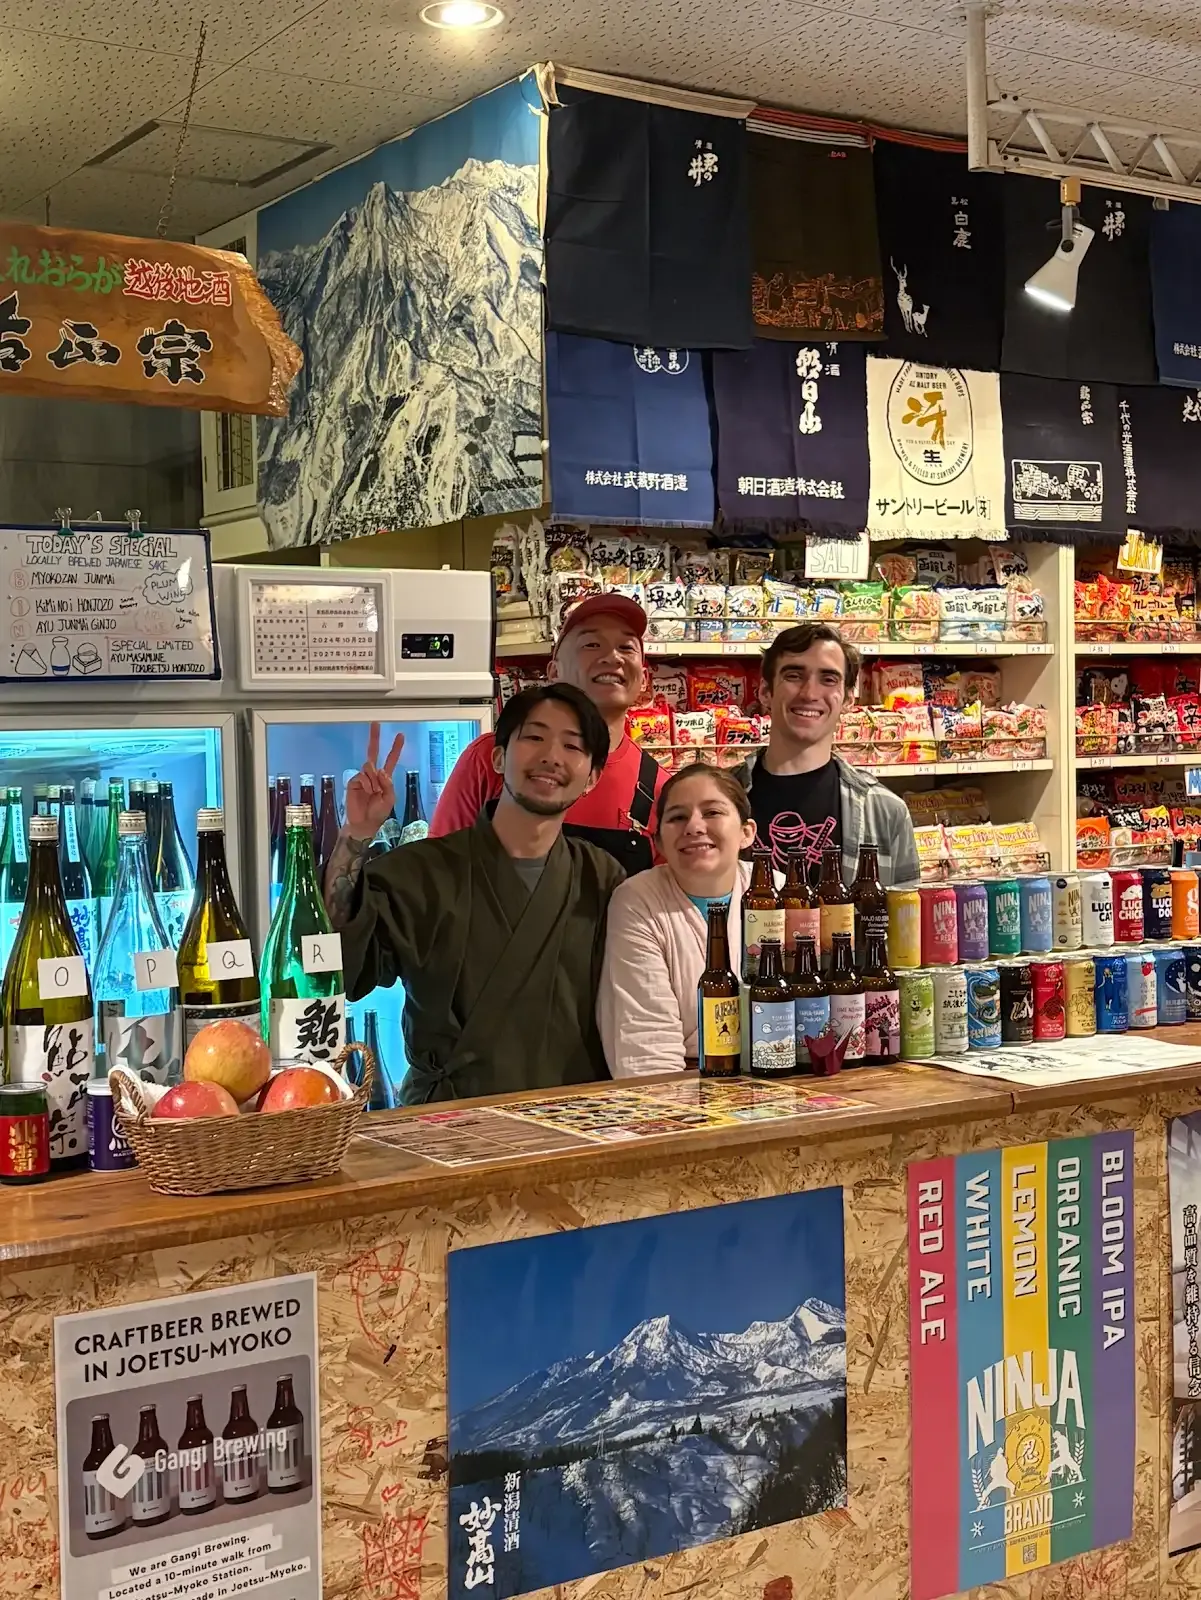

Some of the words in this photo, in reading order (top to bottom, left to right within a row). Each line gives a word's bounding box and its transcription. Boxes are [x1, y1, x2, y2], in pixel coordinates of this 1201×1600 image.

[0, 247, 122, 294] れおらが
[122, 258, 232, 307] 越後地酒
[923, 449, 942, 464] 生
[584, 470, 688, 492] 株式会社武蔵野酒造
[737, 476, 845, 500] 朝日酒造株式会社
[26, 535, 103, 555] TODAY'S
[26, 556, 61, 565] LOCALLY
[68, 557, 102, 567] BREWED
[106, 558, 143, 569] JAPANESE
[148, 560, 168, 570] SAKE
[31, 572, 78, 585] MYOKOZAN
[158, 589, 186, 601] WINE
[36, 619, 54, 634] AYU
[933, 901, 957, 923] NINJ
[963, 899, 988, 924] NINJ
[996, 892, 1020, 914] NINJ
[1028, 892, 1051, 913] NINJ
[1091, 902, 1112, 913] LUC
[222, 950, 245, 970] Q
[312, 944, 325, 964] R
[146, 958, 157, 984] P
[918, 1179, 944, 1254] RED
[1101, 1150, 1125, 1276] BLOOM
[965, 1169, 991, 1302] WHITE
[1012, 1163, 1037, 1299] LEMON
[1057, 1157, 1081, 1318] ORGANIC
[919, 1270, 946, 1345] ALE
[1102, 1287, 1126, 1350] IPA
[74, 1315, 204, 1356] CRAFTBEER
[211, 1298, 301, 1331] BREWED
[84, 1361, 108, 1383] IN
[116, 1327, 292, 1378] JOETSU-MYOKO
[966, 1348, 1086, 1460] NINJA
[154, 1440, 207, 1473] Gangi
[213, 1427, 287, 1461] Brewing
[504, 1470, 521, 1552] 新潟清酒
[1004, 1491, 1054, 1535] BRAND
[129, 1567, 147, 1577] We
[150, 1560, 167, 1571] are
[171, 1548, 201, 1564] Gangi
[204, 1534, 250, 1554] Brewing.
[460, 1496, 502, 1590] 妙高山
[108, 1577, 152, 1600] Located
[165, 1559, 217, 1582] 10-minute
[221, 1552, 245, 1565] walk
[248, 1543, 272, 1557] from
[212, 1566, 252, 1583] Station.
[217, 1588, 227, 1596] in
[231, 1563, 307, 1592] Joetsu-Myoko.
